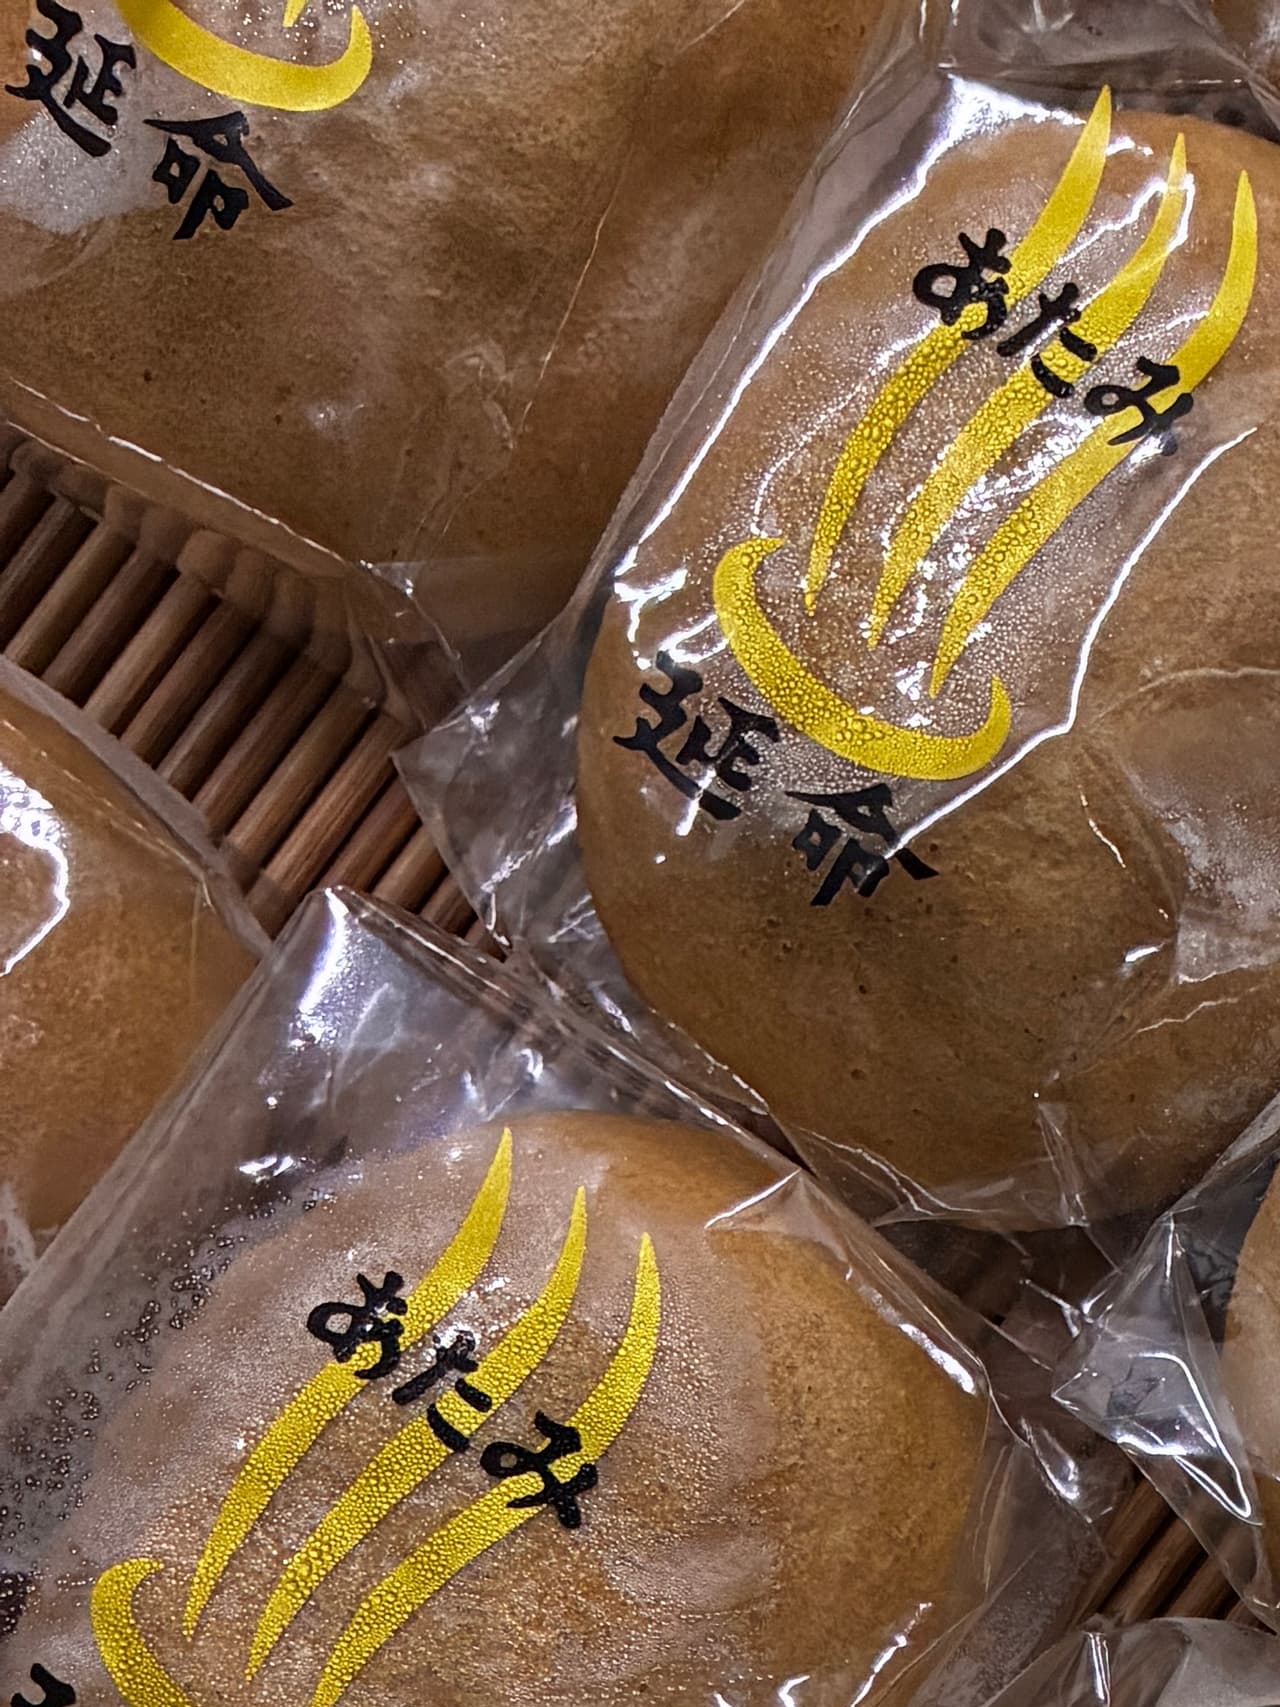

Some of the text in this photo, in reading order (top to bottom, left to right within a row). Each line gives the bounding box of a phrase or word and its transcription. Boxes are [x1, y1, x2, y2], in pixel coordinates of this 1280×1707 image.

[3, 0, 296, 242] 延命
[911, 226, 1195, 457] あたみ
[611, 650, 942, 907] 延命
[304, 1269, 601, 1530] あたみ
